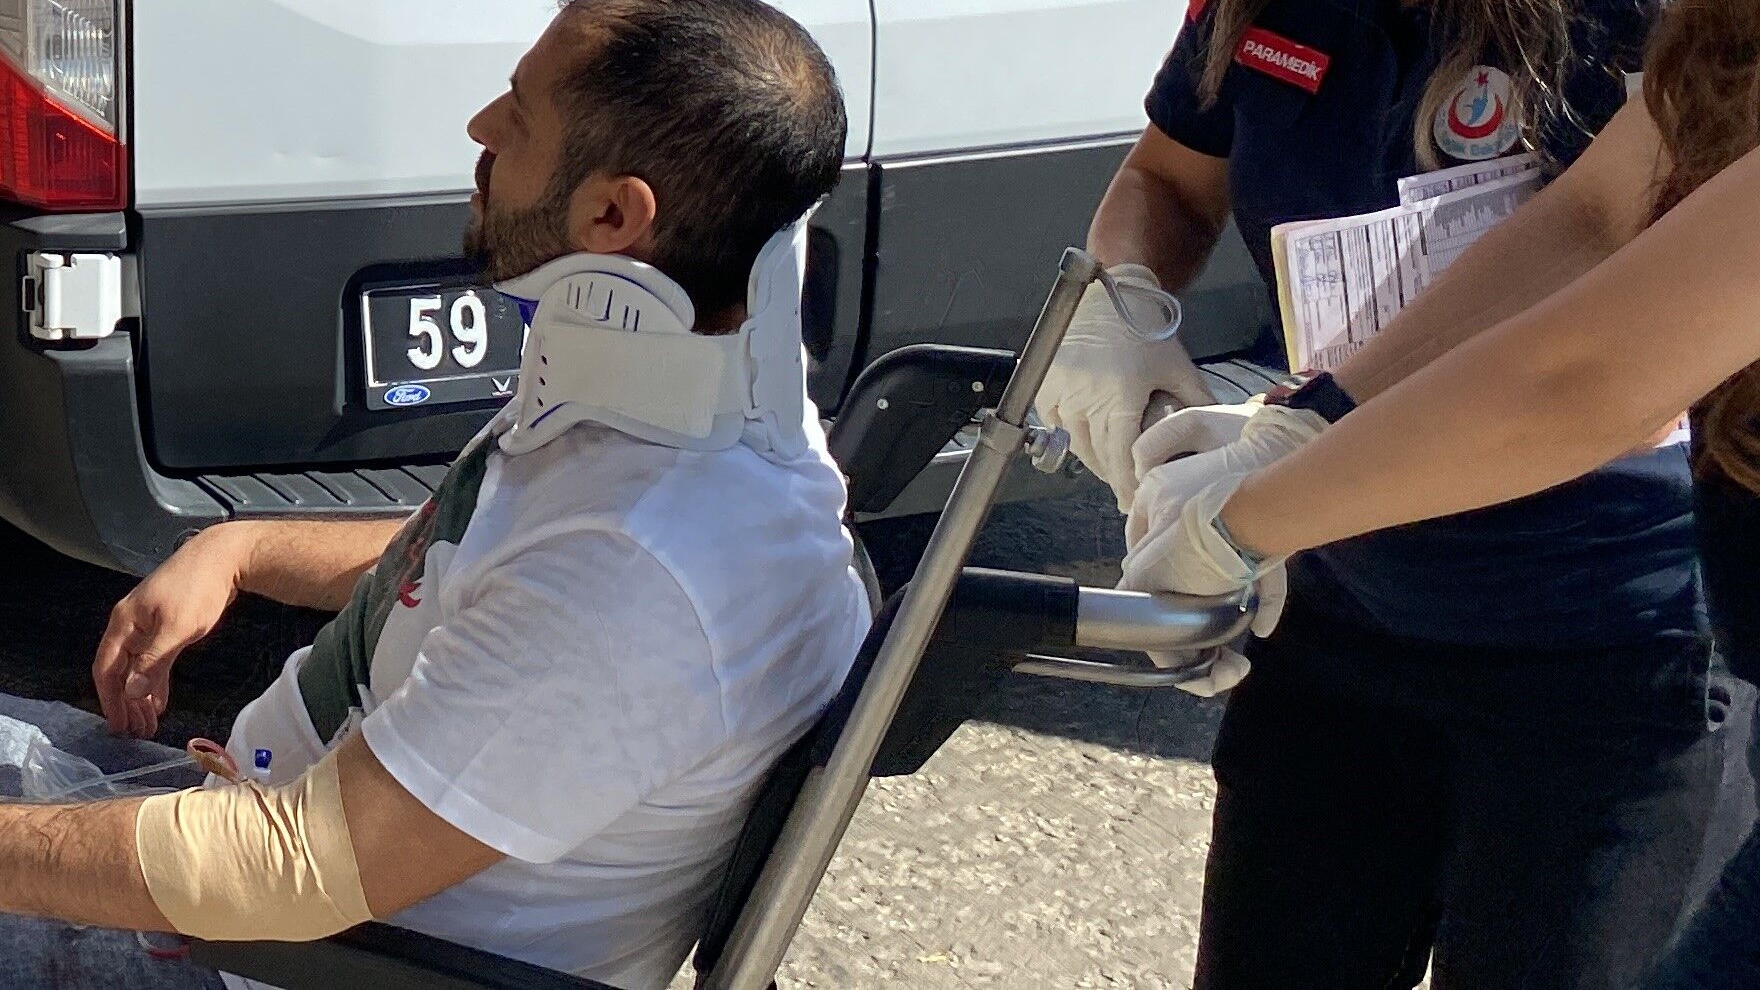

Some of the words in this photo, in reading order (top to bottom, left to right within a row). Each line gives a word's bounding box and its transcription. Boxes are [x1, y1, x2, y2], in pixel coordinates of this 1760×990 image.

[1242, 39, 1322, 82] PARAMEDİK
[406, 294, 488, 370] 59
[389, 388, 426, 404] Ford
